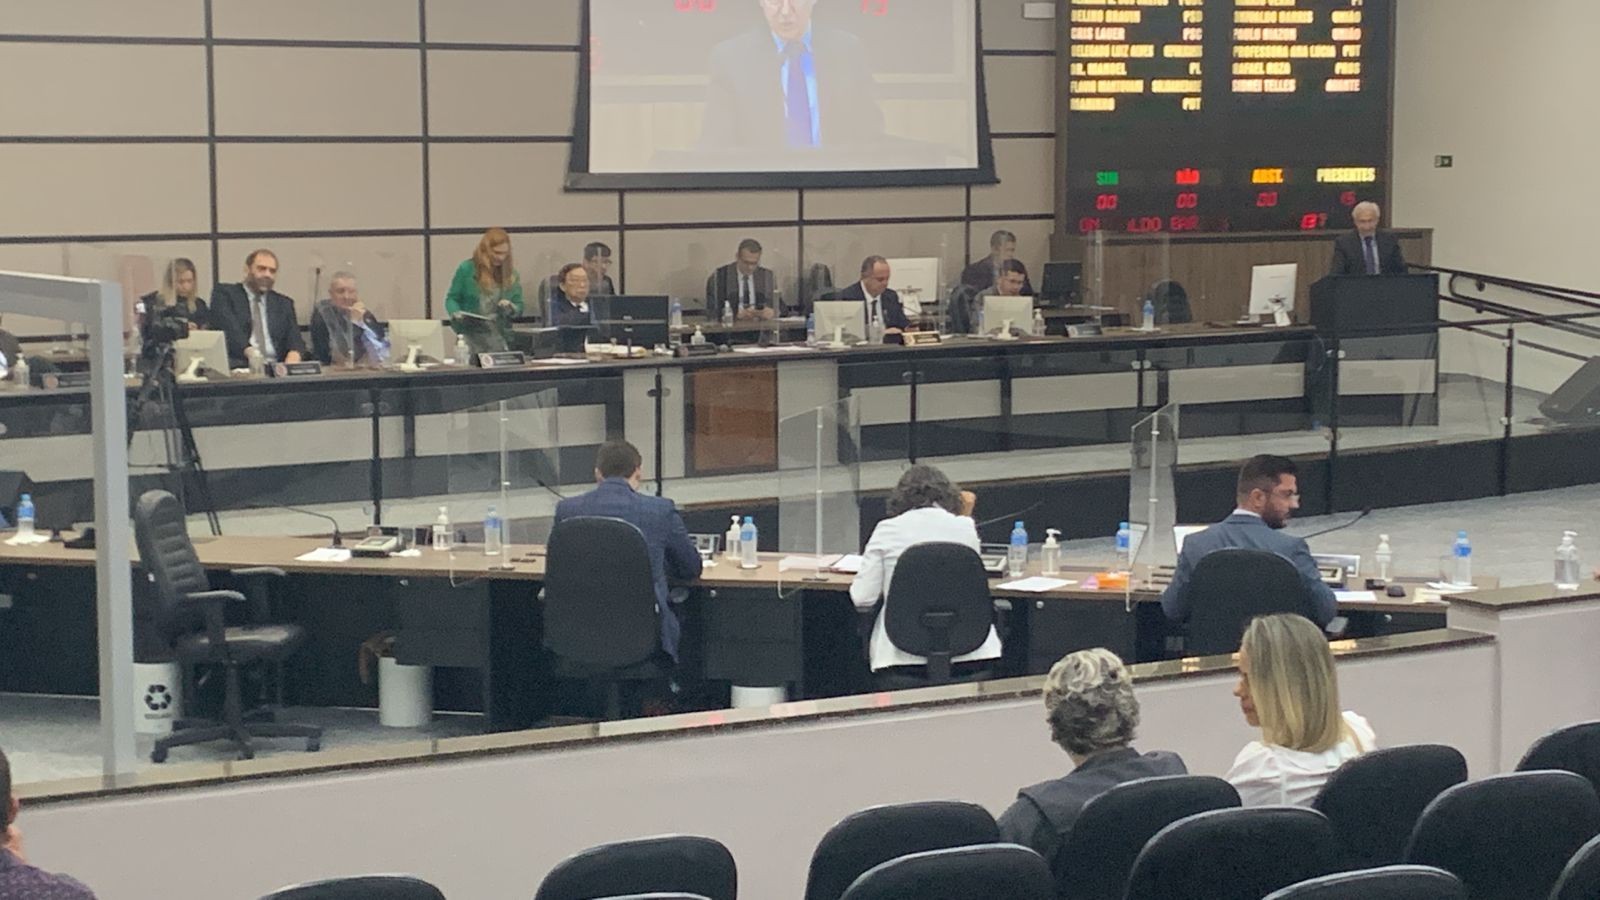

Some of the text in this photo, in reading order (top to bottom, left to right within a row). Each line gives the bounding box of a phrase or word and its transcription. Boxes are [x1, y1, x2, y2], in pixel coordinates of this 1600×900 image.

[1182, 27, 1203, 40] PSC
[1189, 62, 1202, 75] PL
[1263, 79, 1296, 92] TELLES
[1096, 171, 1119, 185] SIM
[1316, 167, 1376, 183] PRESENTES
